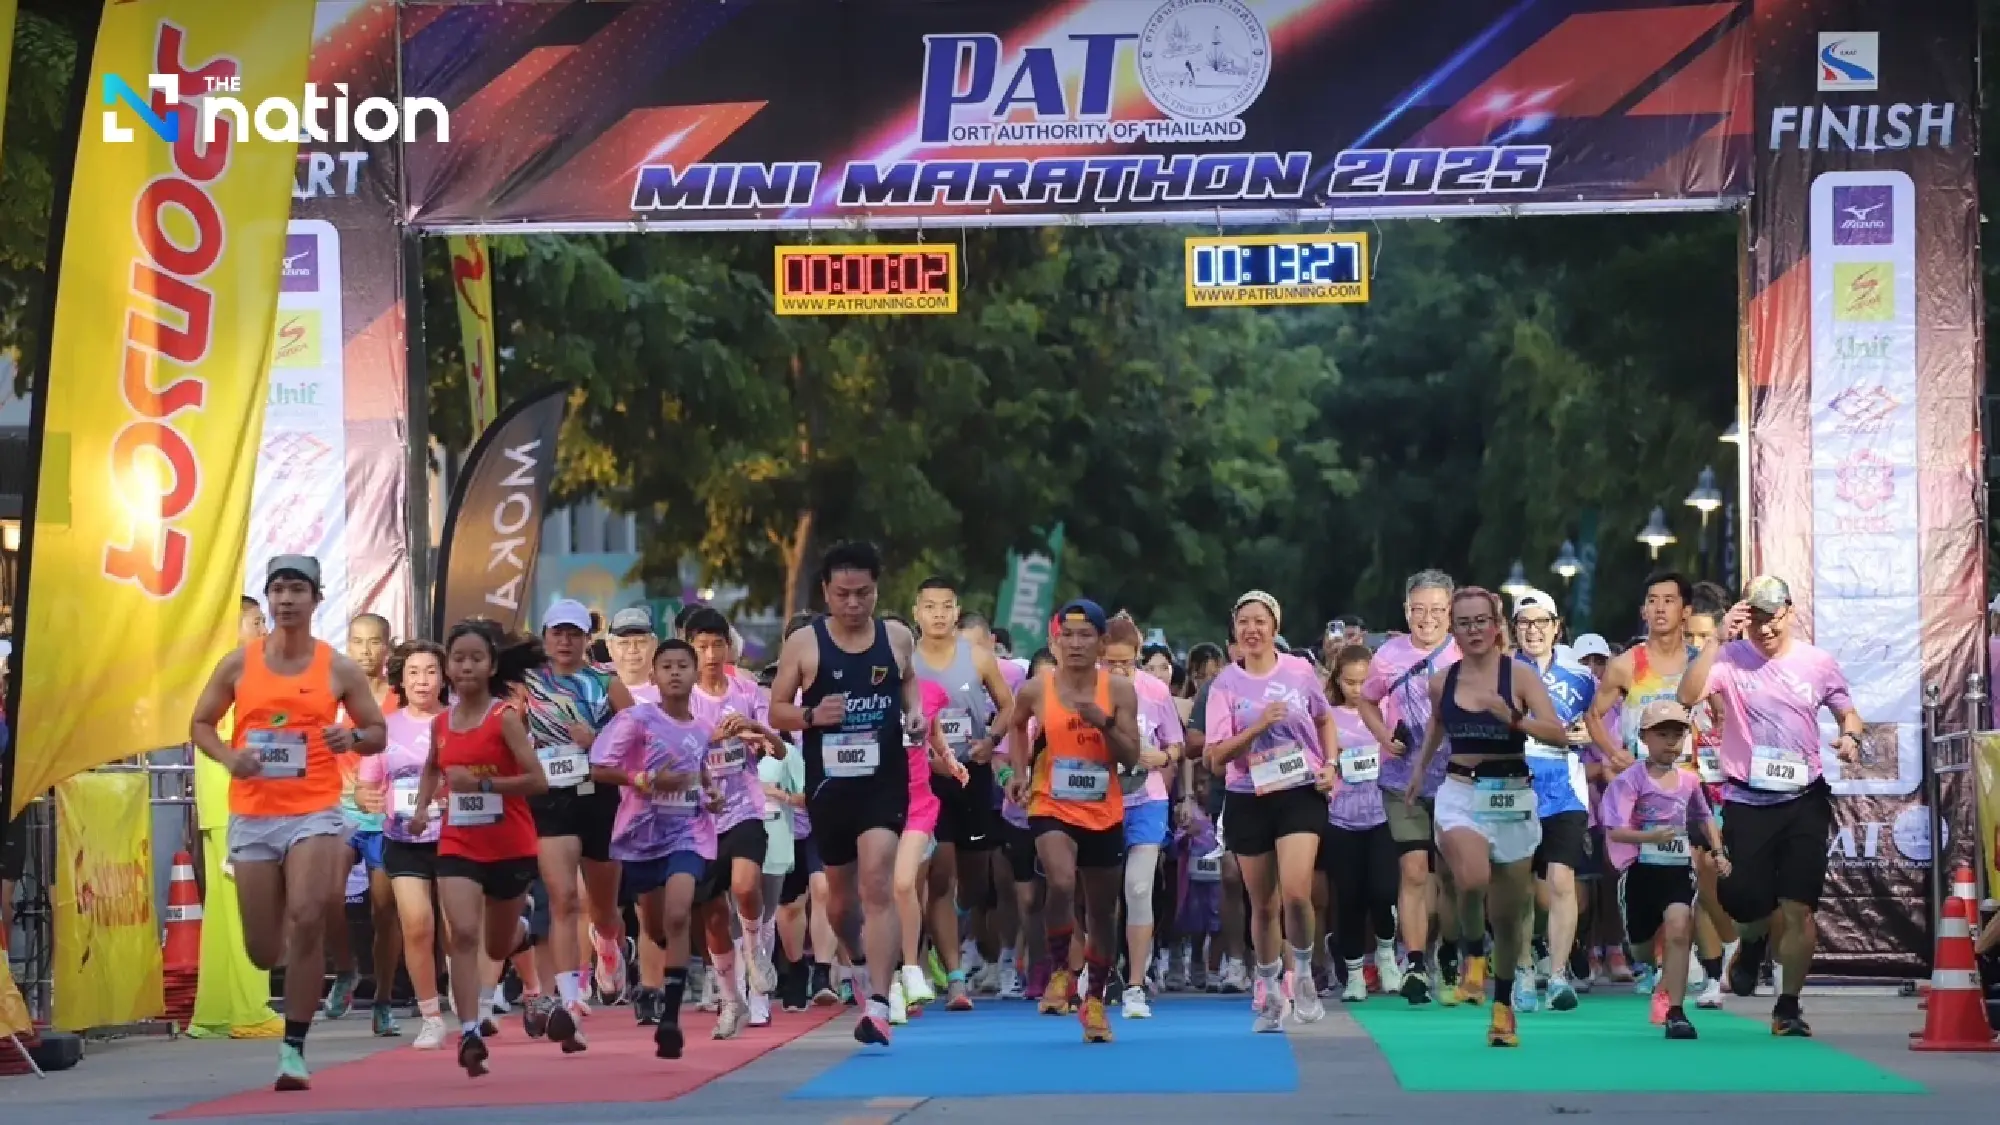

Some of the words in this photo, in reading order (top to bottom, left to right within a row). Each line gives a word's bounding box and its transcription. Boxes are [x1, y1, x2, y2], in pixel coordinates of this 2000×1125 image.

[922, 33, 1139, 142] PAT
[999, 125, 1106, 140] AUTHORITY
[1113, 124, 1138, 139] OF
[1144, 121, 1242, 137] THAILAND
[1769, 102, 1955, 150] FINISH
[632, 163, 820, 210] MINI
[838, 152, 1312, 208] MARATHON
[1328, 146, 1551, 197] 2025
[785, 254, 947, 294] 00:00:02
[1193, 243, 1360, 287] 00:13:27
[782, 297, 949, 311] WWW.PATRUNNING.COM
[1194, 285, 1361, 301] WWW.PATRUNNING.COM
[1008, 550, 1052, 638] Unif
[837, 749, 866, 763] 0002
[1826, 821, 1892, 857] AT
